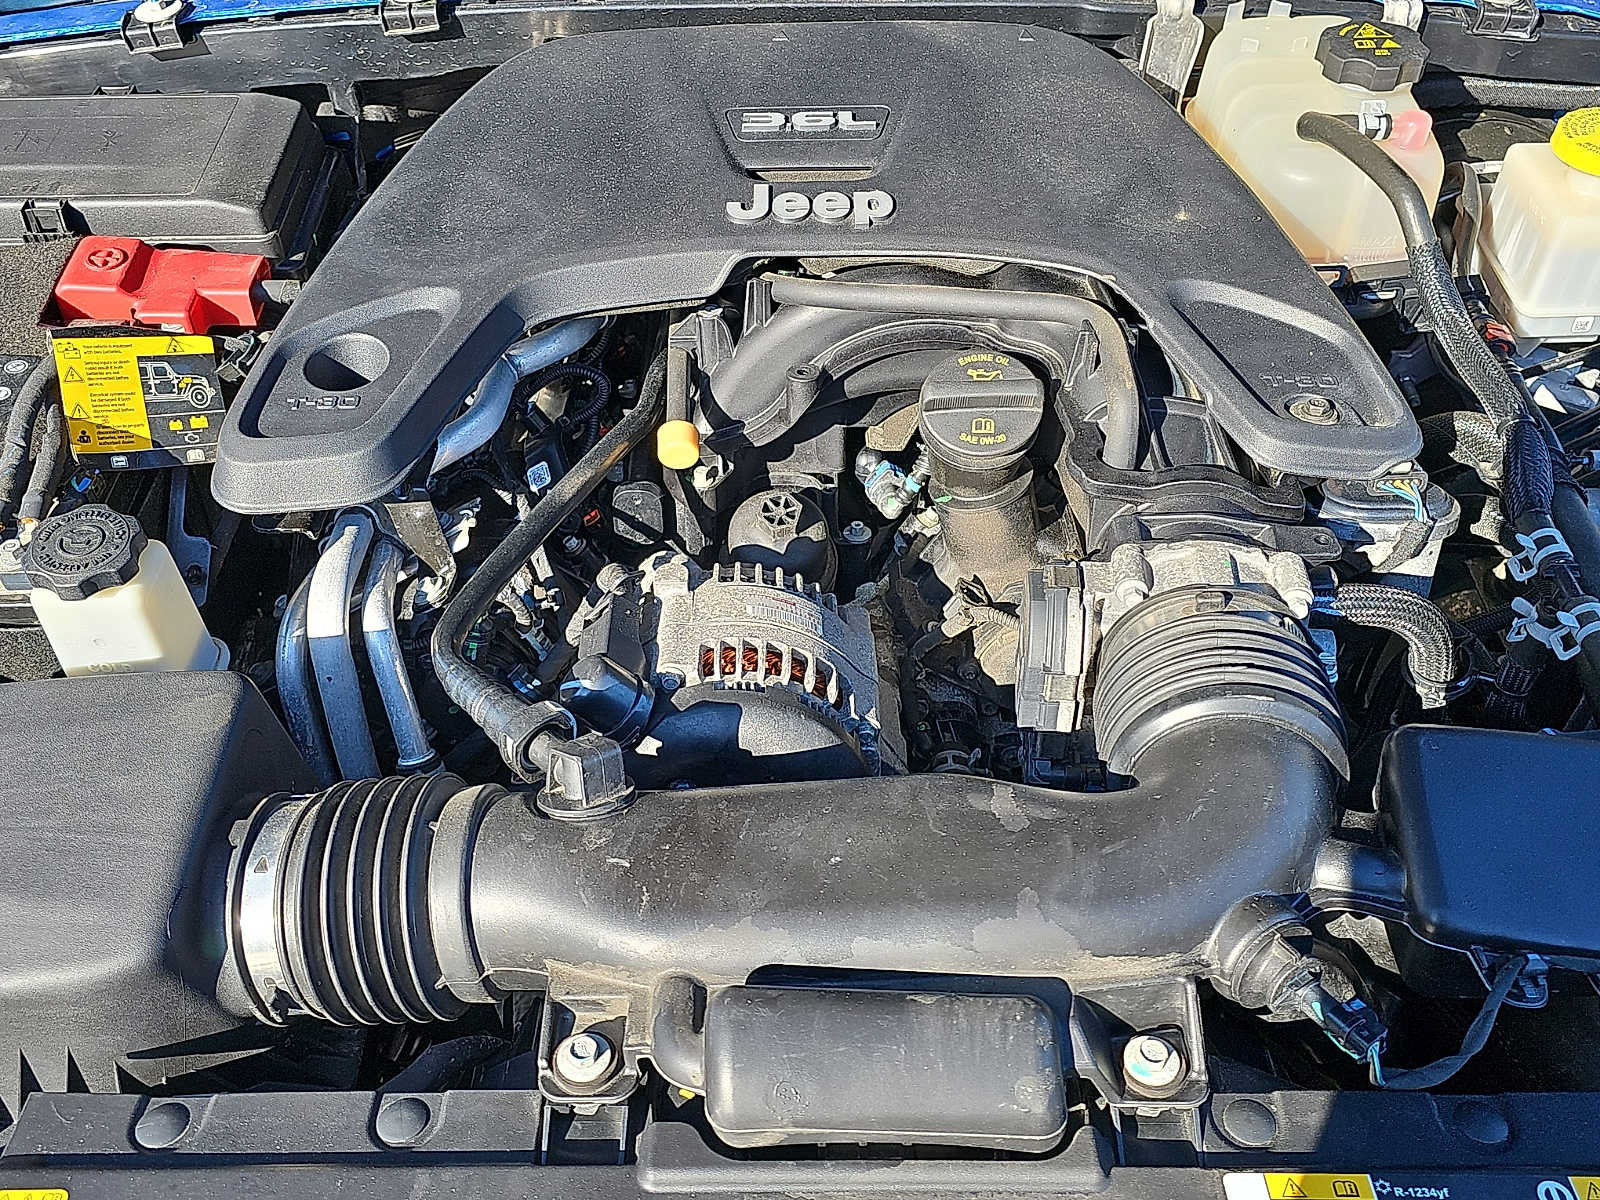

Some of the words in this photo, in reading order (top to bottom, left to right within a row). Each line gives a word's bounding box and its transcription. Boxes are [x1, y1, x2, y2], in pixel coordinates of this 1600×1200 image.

[741, 111, 877, 132] 3.6L
[726, 184, 895, 228] Jeep
[958, 354, 994, 366] ENGINE
[995, 355, 1010, 366] OIL
[959, 433, 979, 445] SAE
[979, 433, 1007, 445] 0W-20
[1394, 1186, 1450, 1199] R-1234yf
